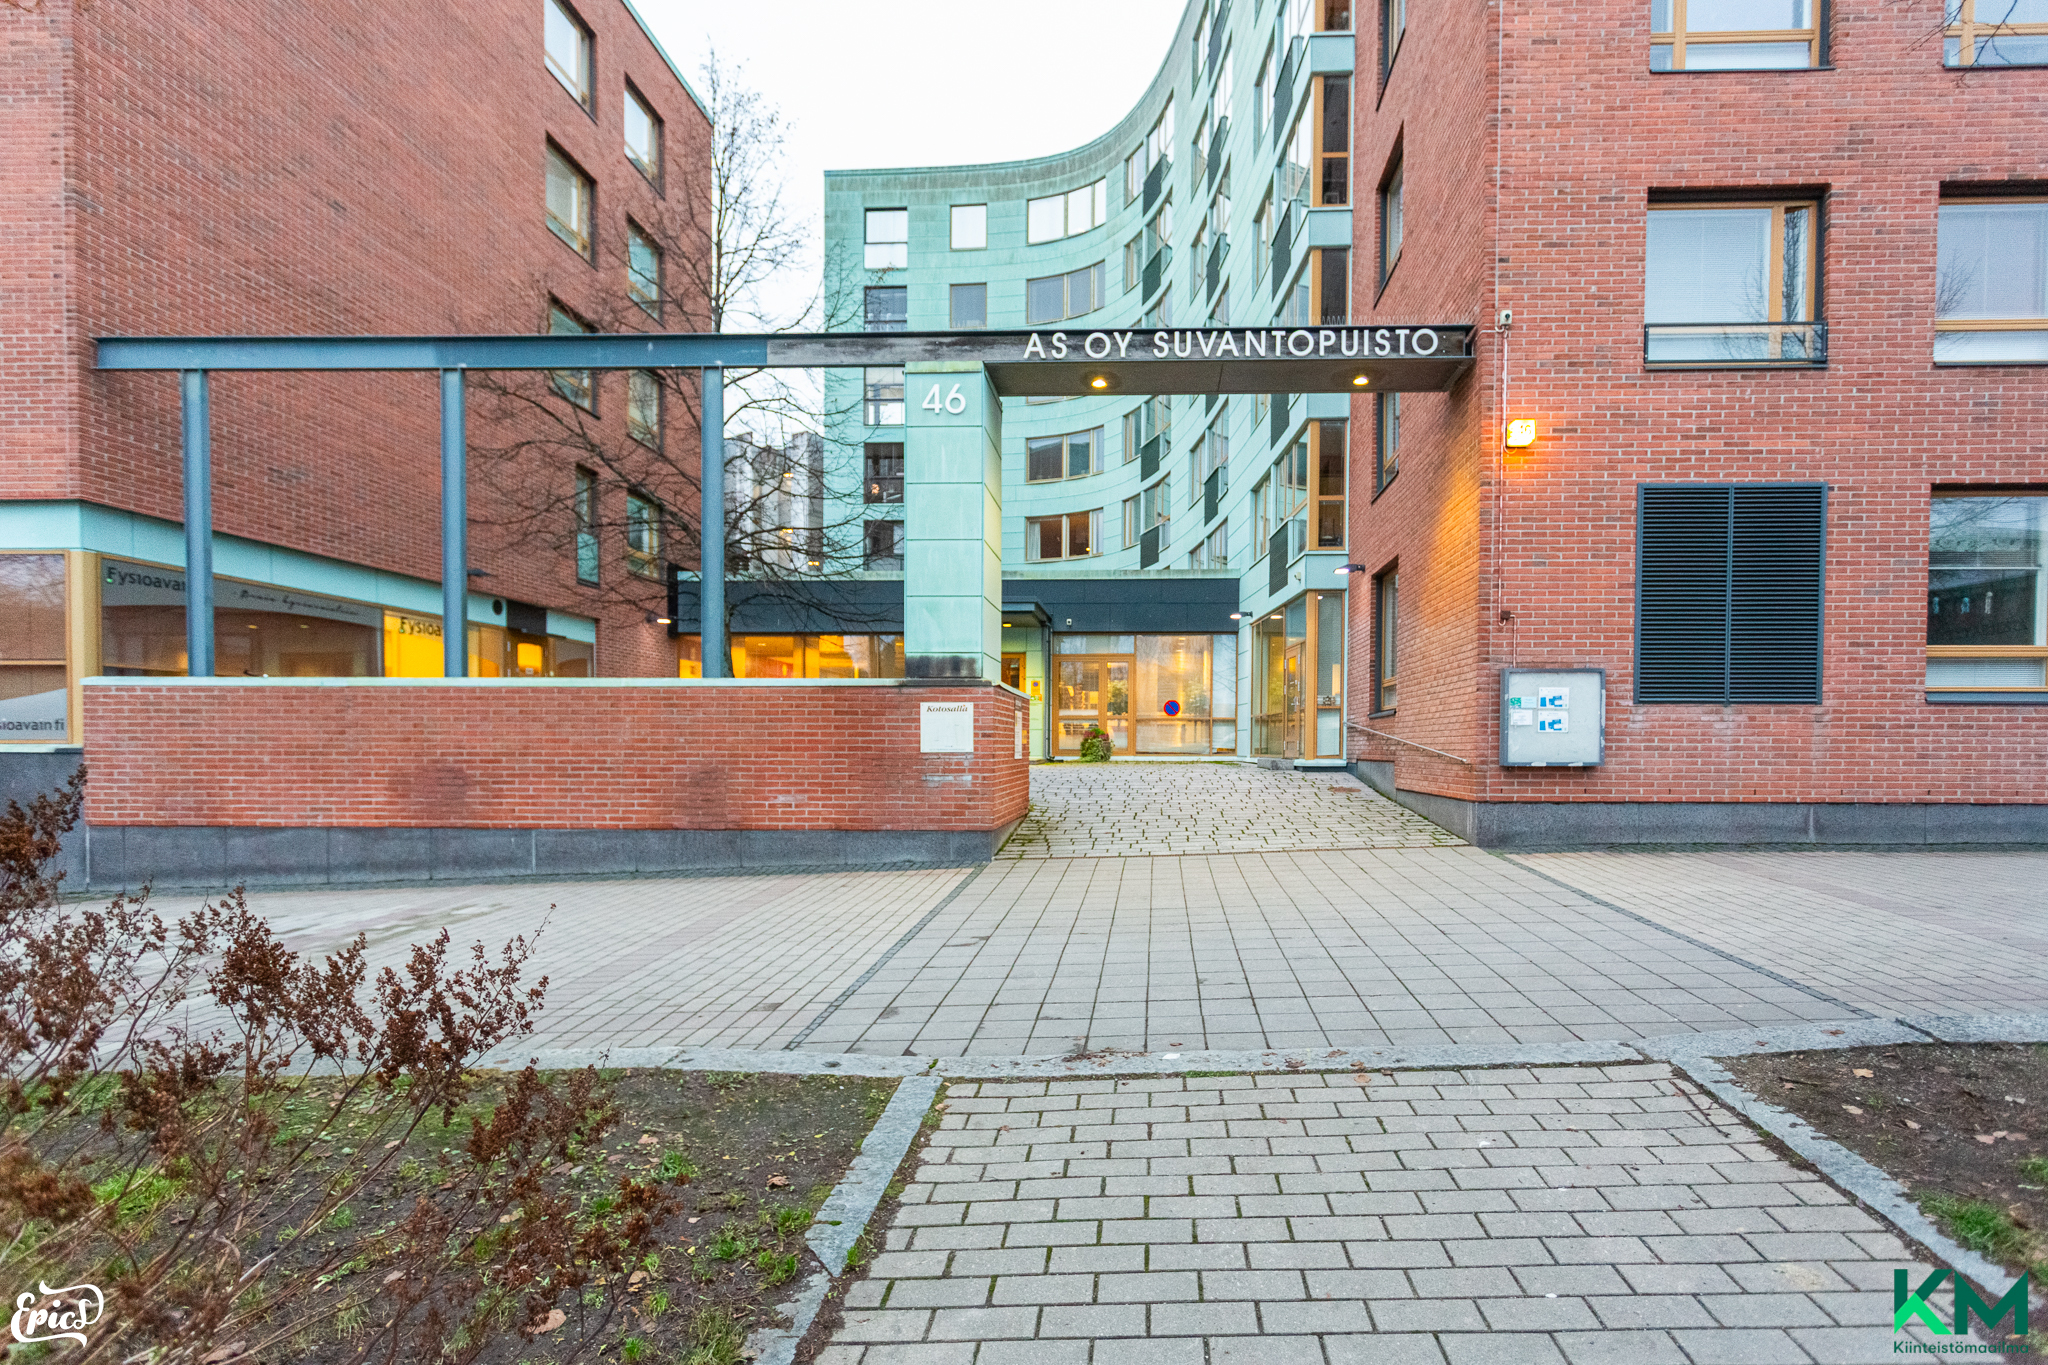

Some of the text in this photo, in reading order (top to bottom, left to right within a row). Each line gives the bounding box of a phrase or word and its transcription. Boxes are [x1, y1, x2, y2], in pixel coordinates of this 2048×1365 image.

[1023, 328, 1438, 359] AS OY SUVANTOPUISTO
[921, 383, 966, 415] 46
[926, 704, 968, 712] Kotosalla
